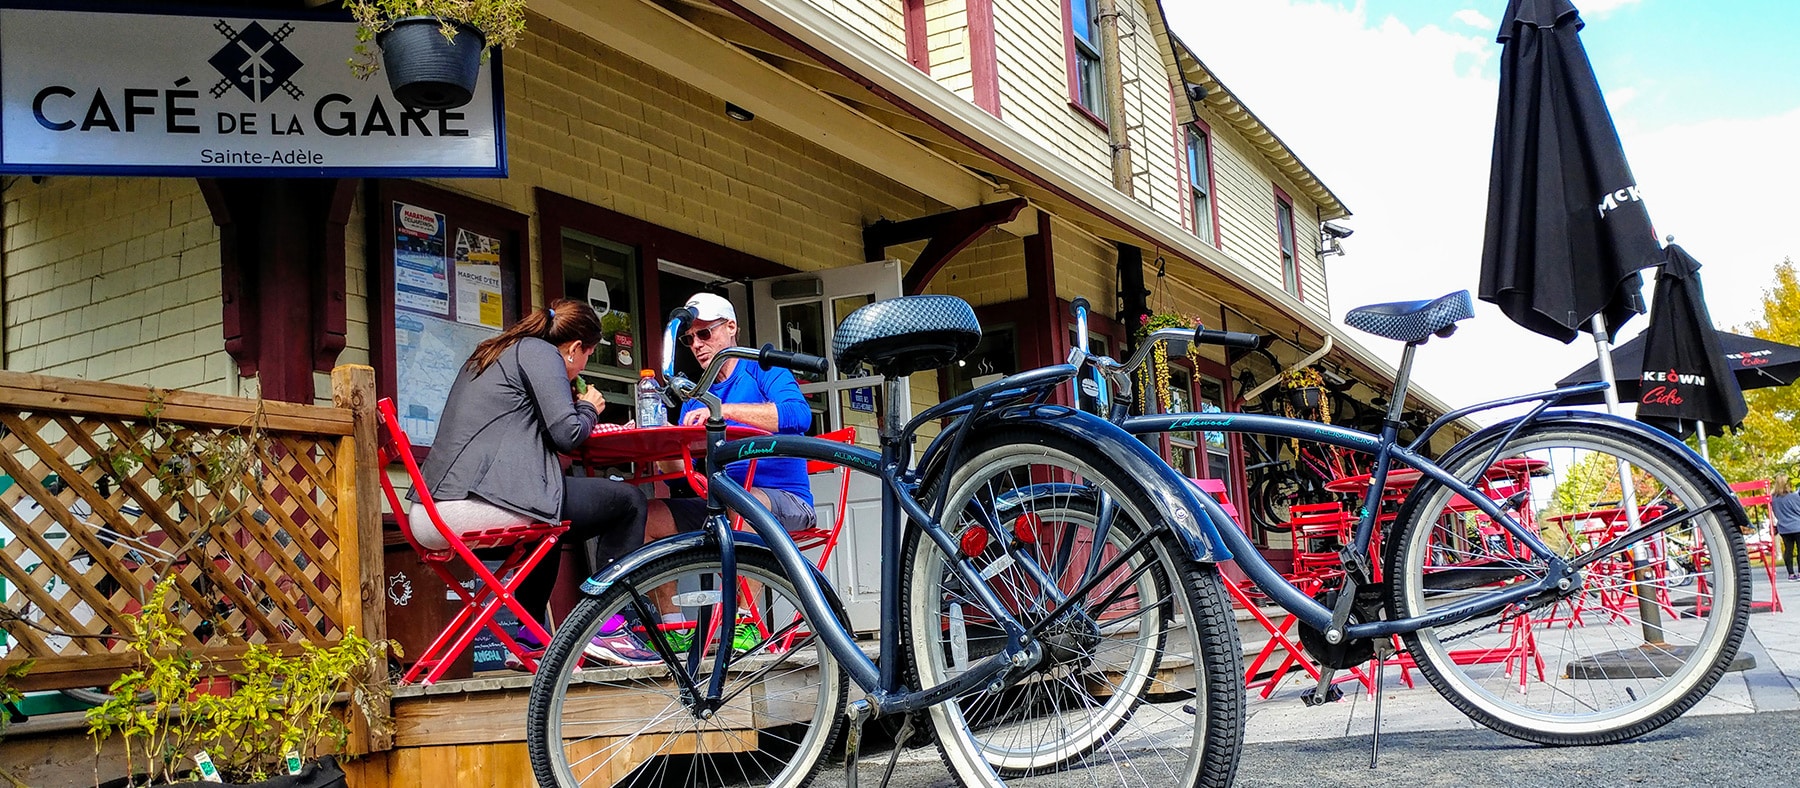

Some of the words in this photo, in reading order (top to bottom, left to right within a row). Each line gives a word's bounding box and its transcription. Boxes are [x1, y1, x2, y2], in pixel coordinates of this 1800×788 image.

[32, 76, 200, 134] CAFÉ
[218, 112, 256, 135] DE
[271, 113, 304, 136] LA
[313, 93, 470, 137] GARE
[200, 148, 324, 165] Sainte-Adèle
[1642, 385, 1683, 407] Cidre
[1168, 415, 1237, 430] Lakewood
[1314, 427, 1375, 446] ALUMINUM
[834, 450, 878, 470] ALUMINUM
